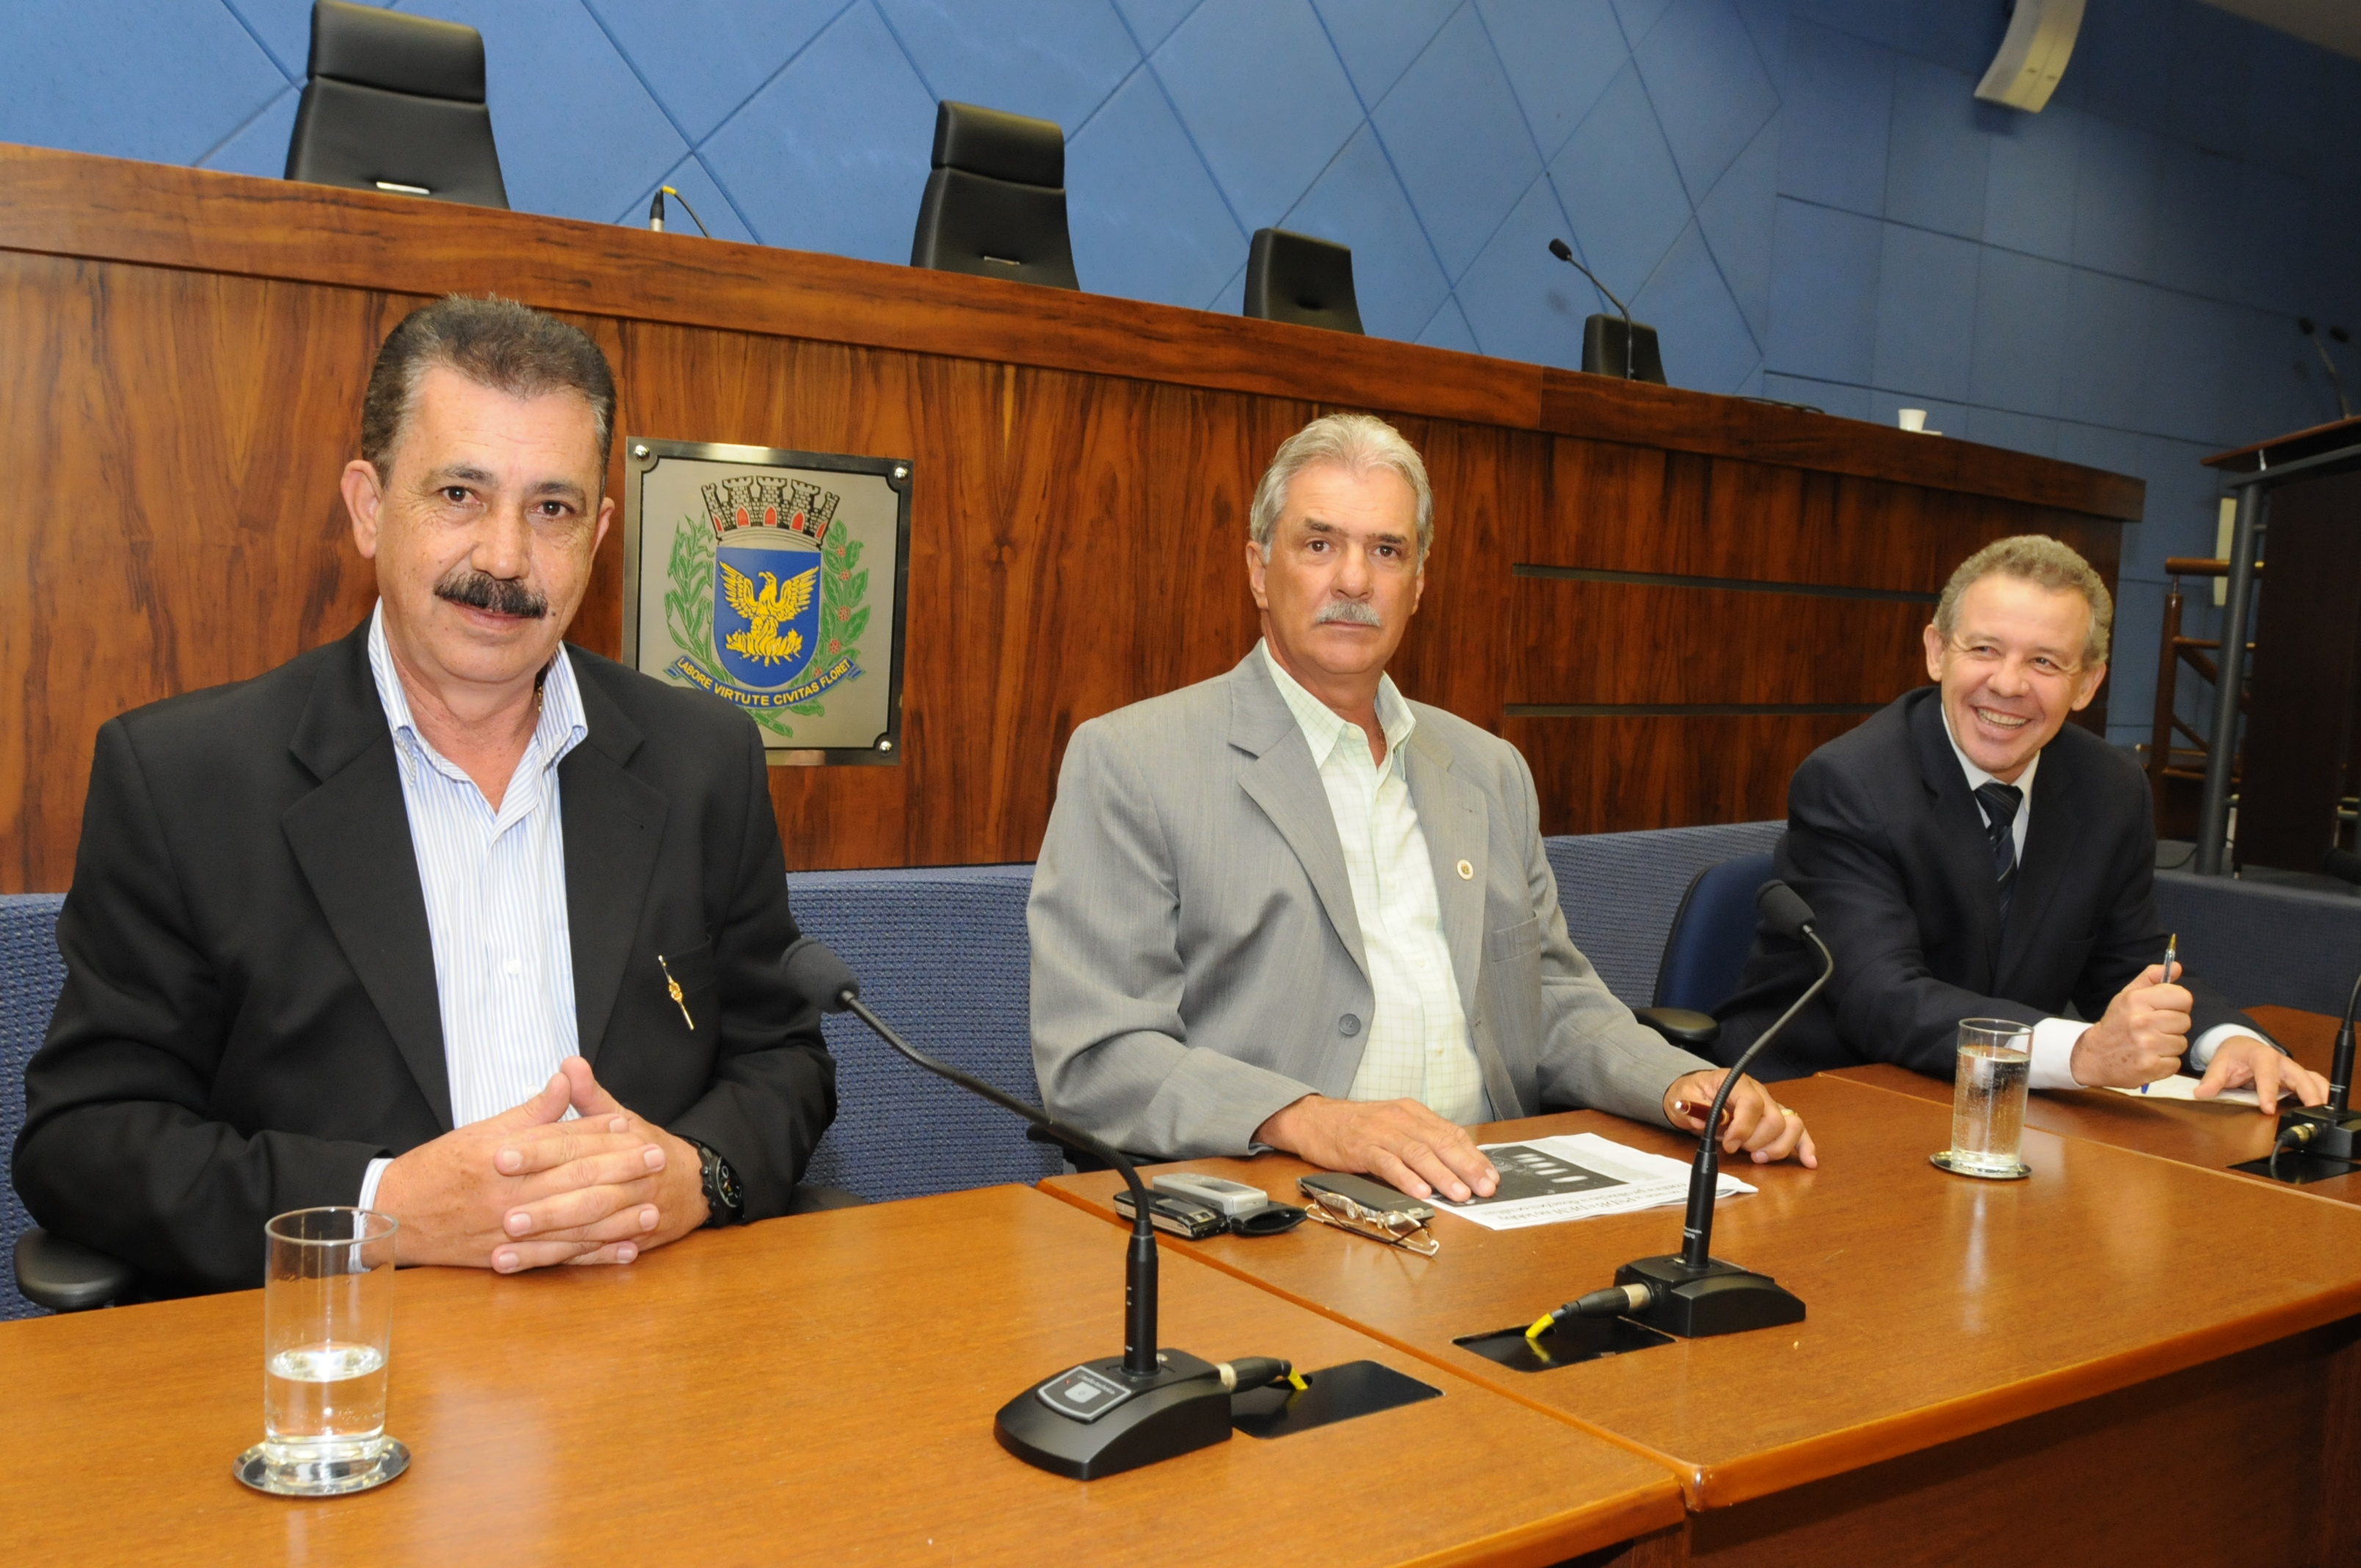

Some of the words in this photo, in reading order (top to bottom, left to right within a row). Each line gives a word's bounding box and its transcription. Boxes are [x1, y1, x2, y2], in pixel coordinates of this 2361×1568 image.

[676, 658, 714, 689] LABORE
[714, 683, 769, 706] VIRTUTE
[773, 682, 820, 705] CIVITAS
[819, 658, 851, 689] FLORET
